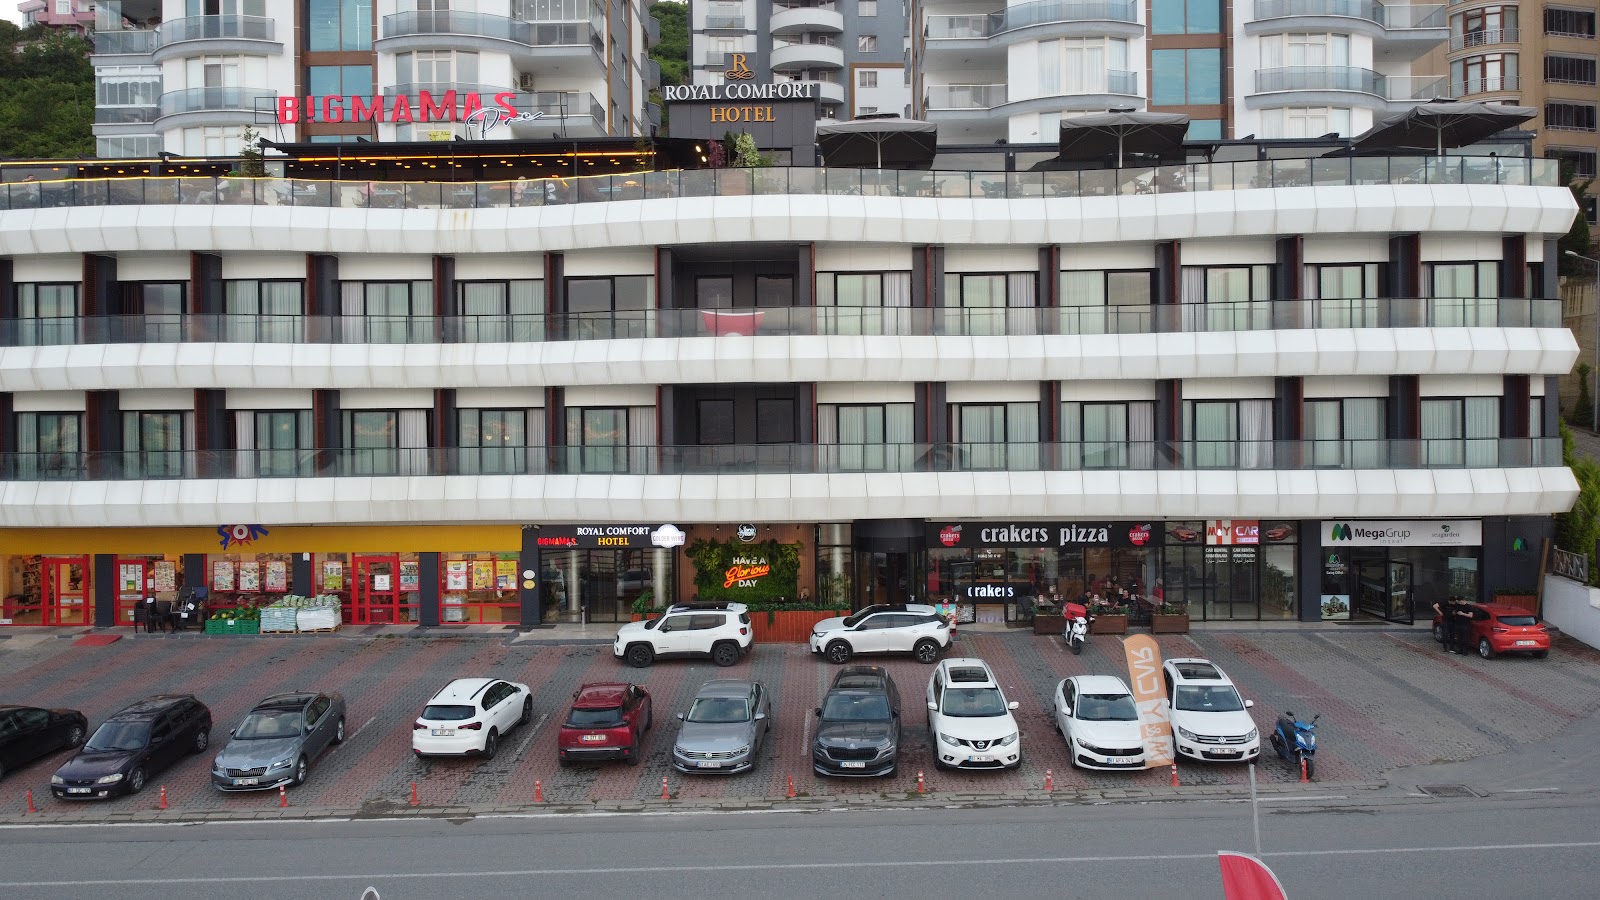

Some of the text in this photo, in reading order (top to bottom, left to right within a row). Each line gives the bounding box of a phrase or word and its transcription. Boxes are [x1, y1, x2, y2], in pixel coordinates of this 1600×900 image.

[665, 83, 815, 101] ROYAL COMFORT
[710, 106, 776, 123] HOTEL
[577, 526, 650, 536] ROYAL COMFORT
[980, 523, 1109, 546] crakers pizza
[1208, 525, 1259, 537] M&Y CAR
[1354, 527, 1411, 540] MegaGrup
[597, 537, 630, 546] HOTEL
[732, 556, 767, 565] HAVE A
[723, 564, 770, 589] Glorious
[738, 579, 758, 588] DAY
